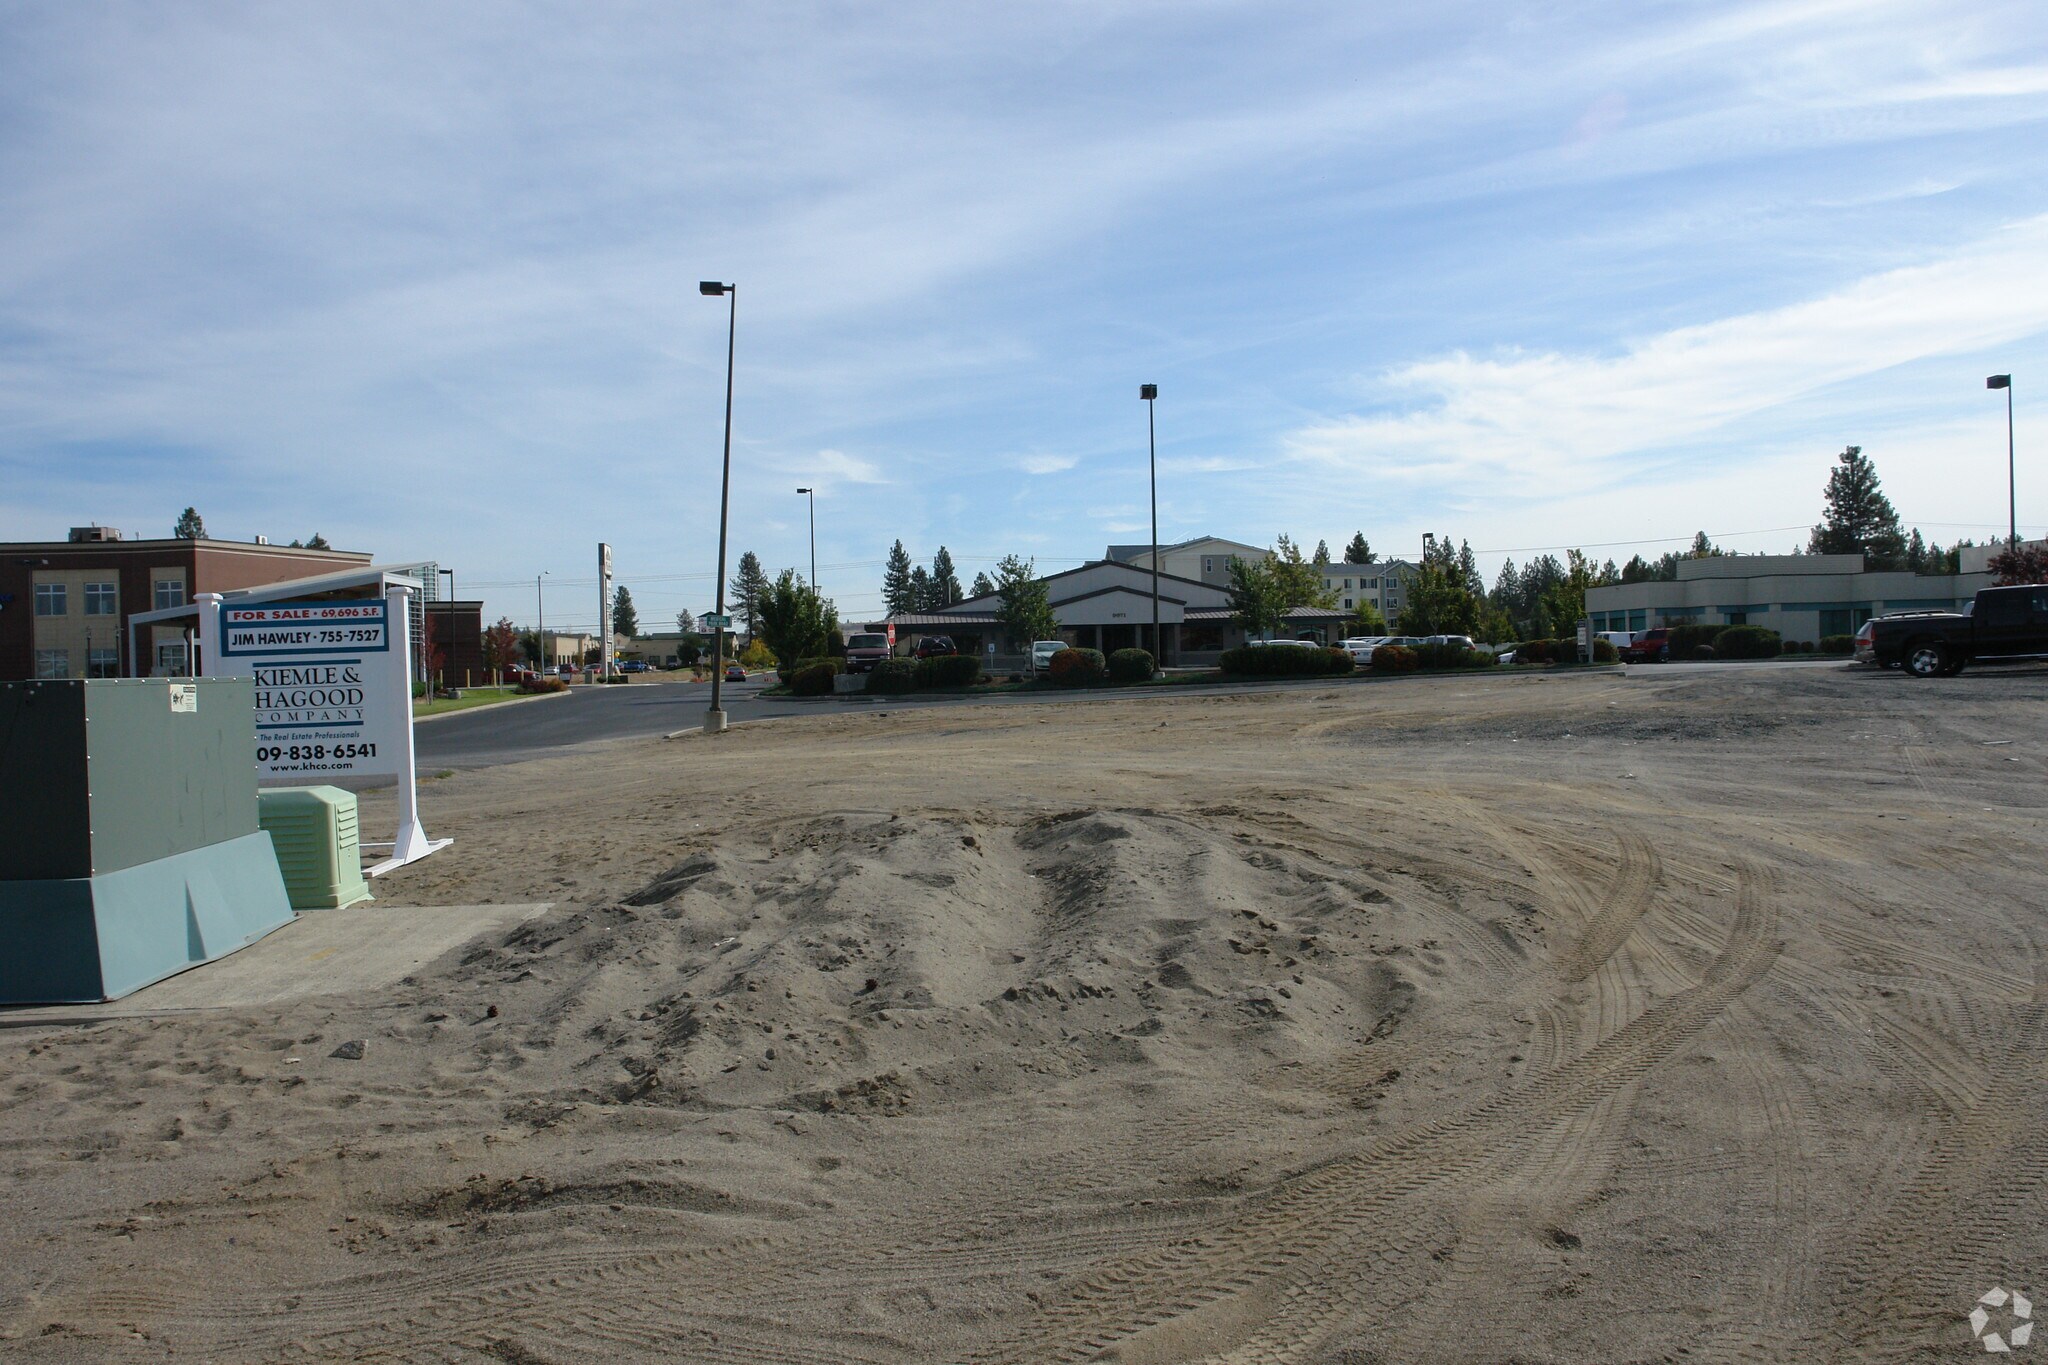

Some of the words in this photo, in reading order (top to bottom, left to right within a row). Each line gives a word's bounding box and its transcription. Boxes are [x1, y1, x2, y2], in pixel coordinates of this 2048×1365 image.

[233, 611, 266, 621] FOR
[272, 609, 310, 619] SALE
[321, 608, 359, 618] 69,696
[362, 607, 380, 617] S.F.
[231, 633, 255, 646] JIM
[258, 632, 311, 645] HAWLEY
[320, 630, 380, 643] 755-7527
[253, 667, 338, 687] KIEMLE
[342, 666, 363, 684] &
[254, 688, 364, 709] HAGOOD
[255, 709, 364, 723] COMPANY
[274, 733, 289, 741] Real
[291, 732, 313, 740] Estate
[314, 730, 360, 740] Professionals
[256, 743, 377, 762] 09-838-6541
[270, 762, 353, 772] www.khco.com
